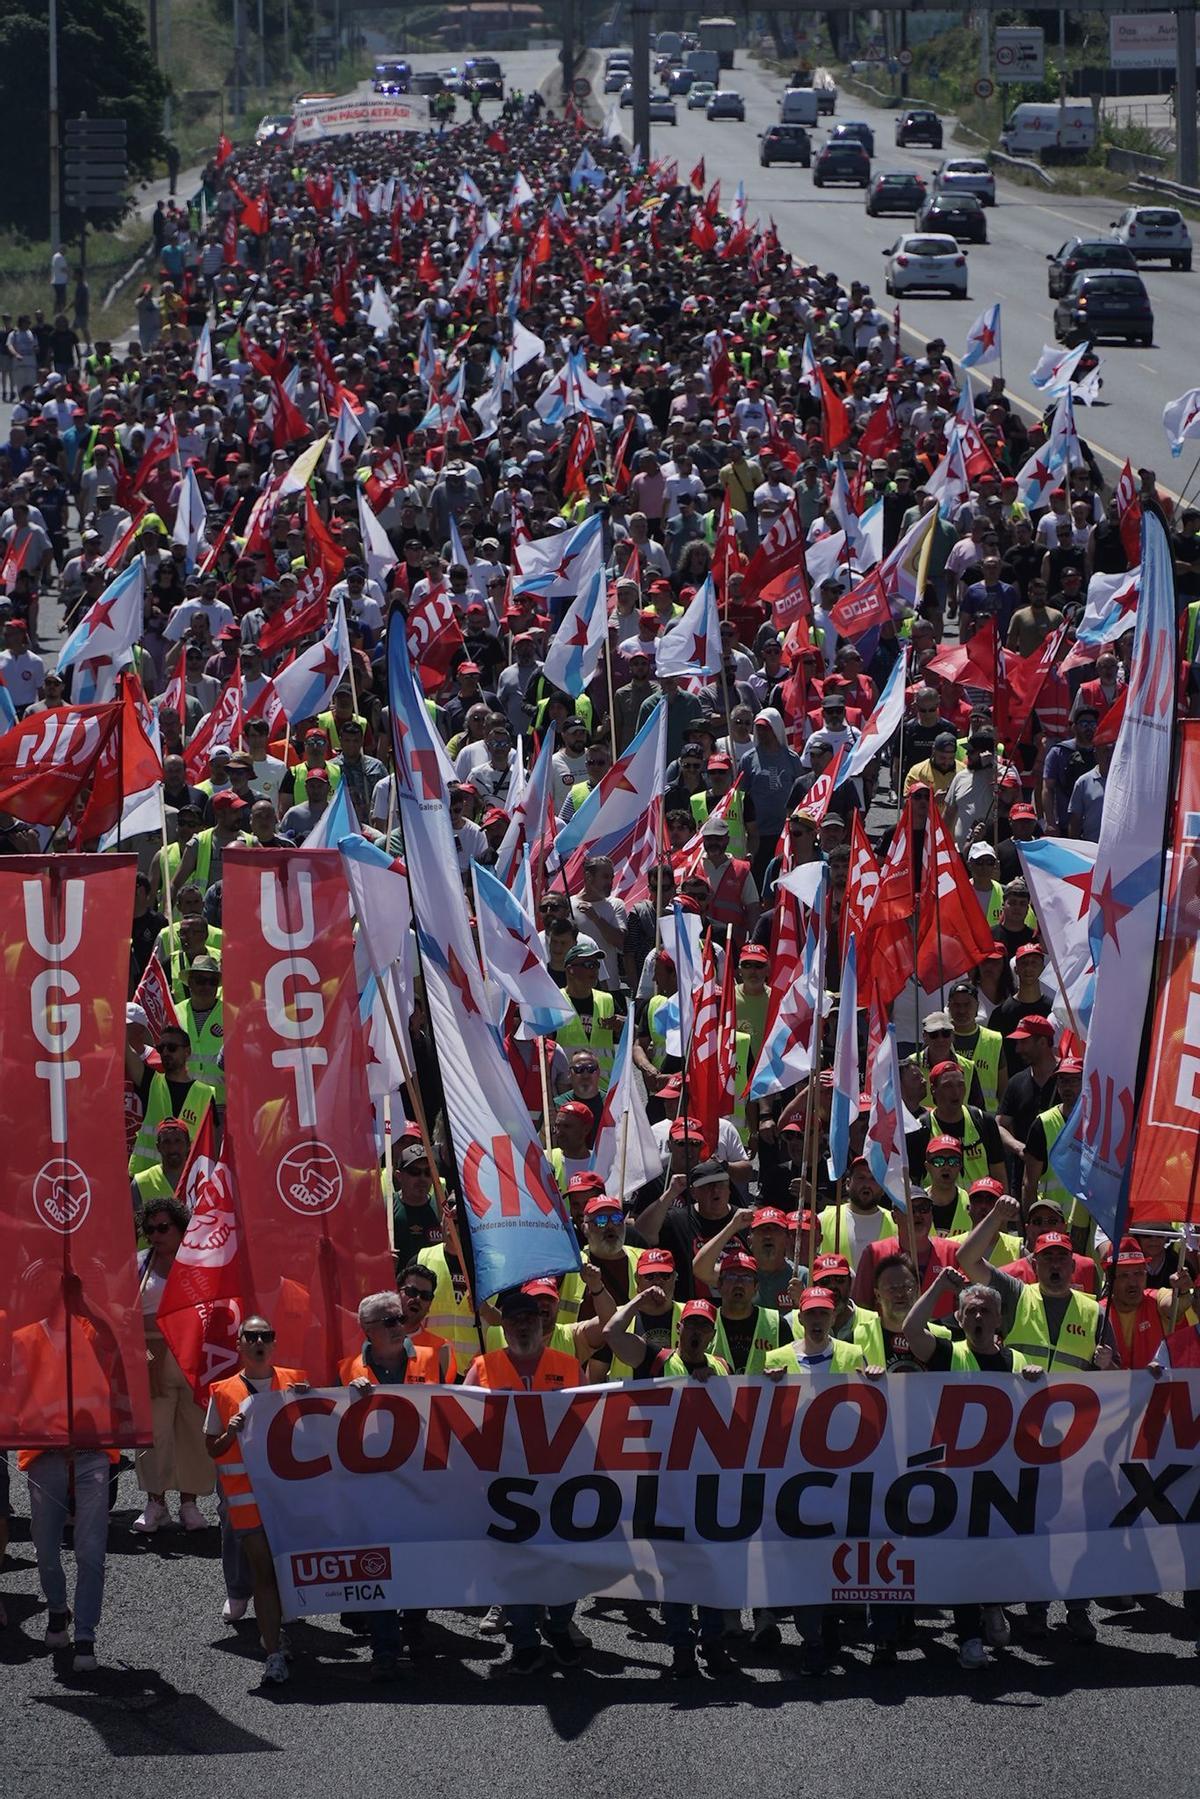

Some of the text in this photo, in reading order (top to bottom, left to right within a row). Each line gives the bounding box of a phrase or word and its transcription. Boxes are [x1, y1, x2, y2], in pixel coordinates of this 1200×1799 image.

[23, 880, 85, 1143] UGT
[260, 871, 328, 1127] UGT
[267, 1382, 888, 1481] CONVENIO
[926, 1383, 1101, 1469] DO
[486, 1446, 1041, 1543] SOLUCIÓN
[296, 1554, 357, 1581] UGT
[344, 1584, 386, 1602] FICA
[832, 1541, 915, 1585] CIG
[833, 1590, 914, 1600] INDUSTRIA
